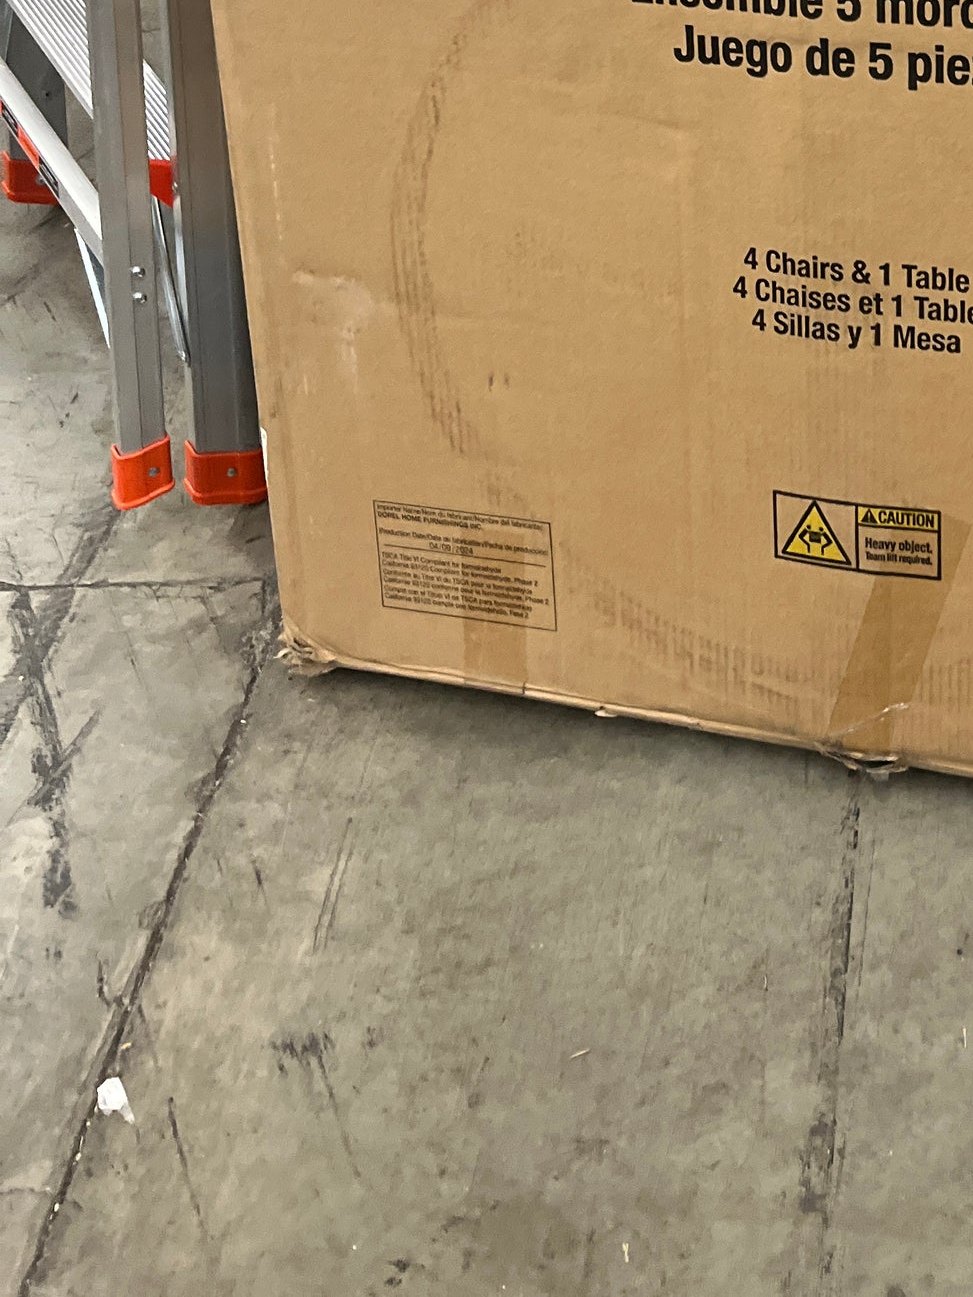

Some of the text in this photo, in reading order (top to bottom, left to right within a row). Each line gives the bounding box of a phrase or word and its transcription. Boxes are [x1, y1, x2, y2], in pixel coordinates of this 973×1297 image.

[673, 25, 792, 78] Juego
[805, 38, 855, 79] de
[868, 42, 894, 81] 5
[743, 247, 970, 293] 4 Chairs & 1 Table
[732, 276, 748, 299] 4
[755, 278, 851, 313] Chaises
[858, 293, 884, 316] et
[891, 295, 902, 317] 1
[751, 308, 961, 354] 4 Sillas y 1 Mesa
[878, 510, 935, 528] CAUTION
[865, 537, 933, 554] Heavy object.
[865, 551, 933, 566] Team lift required.
